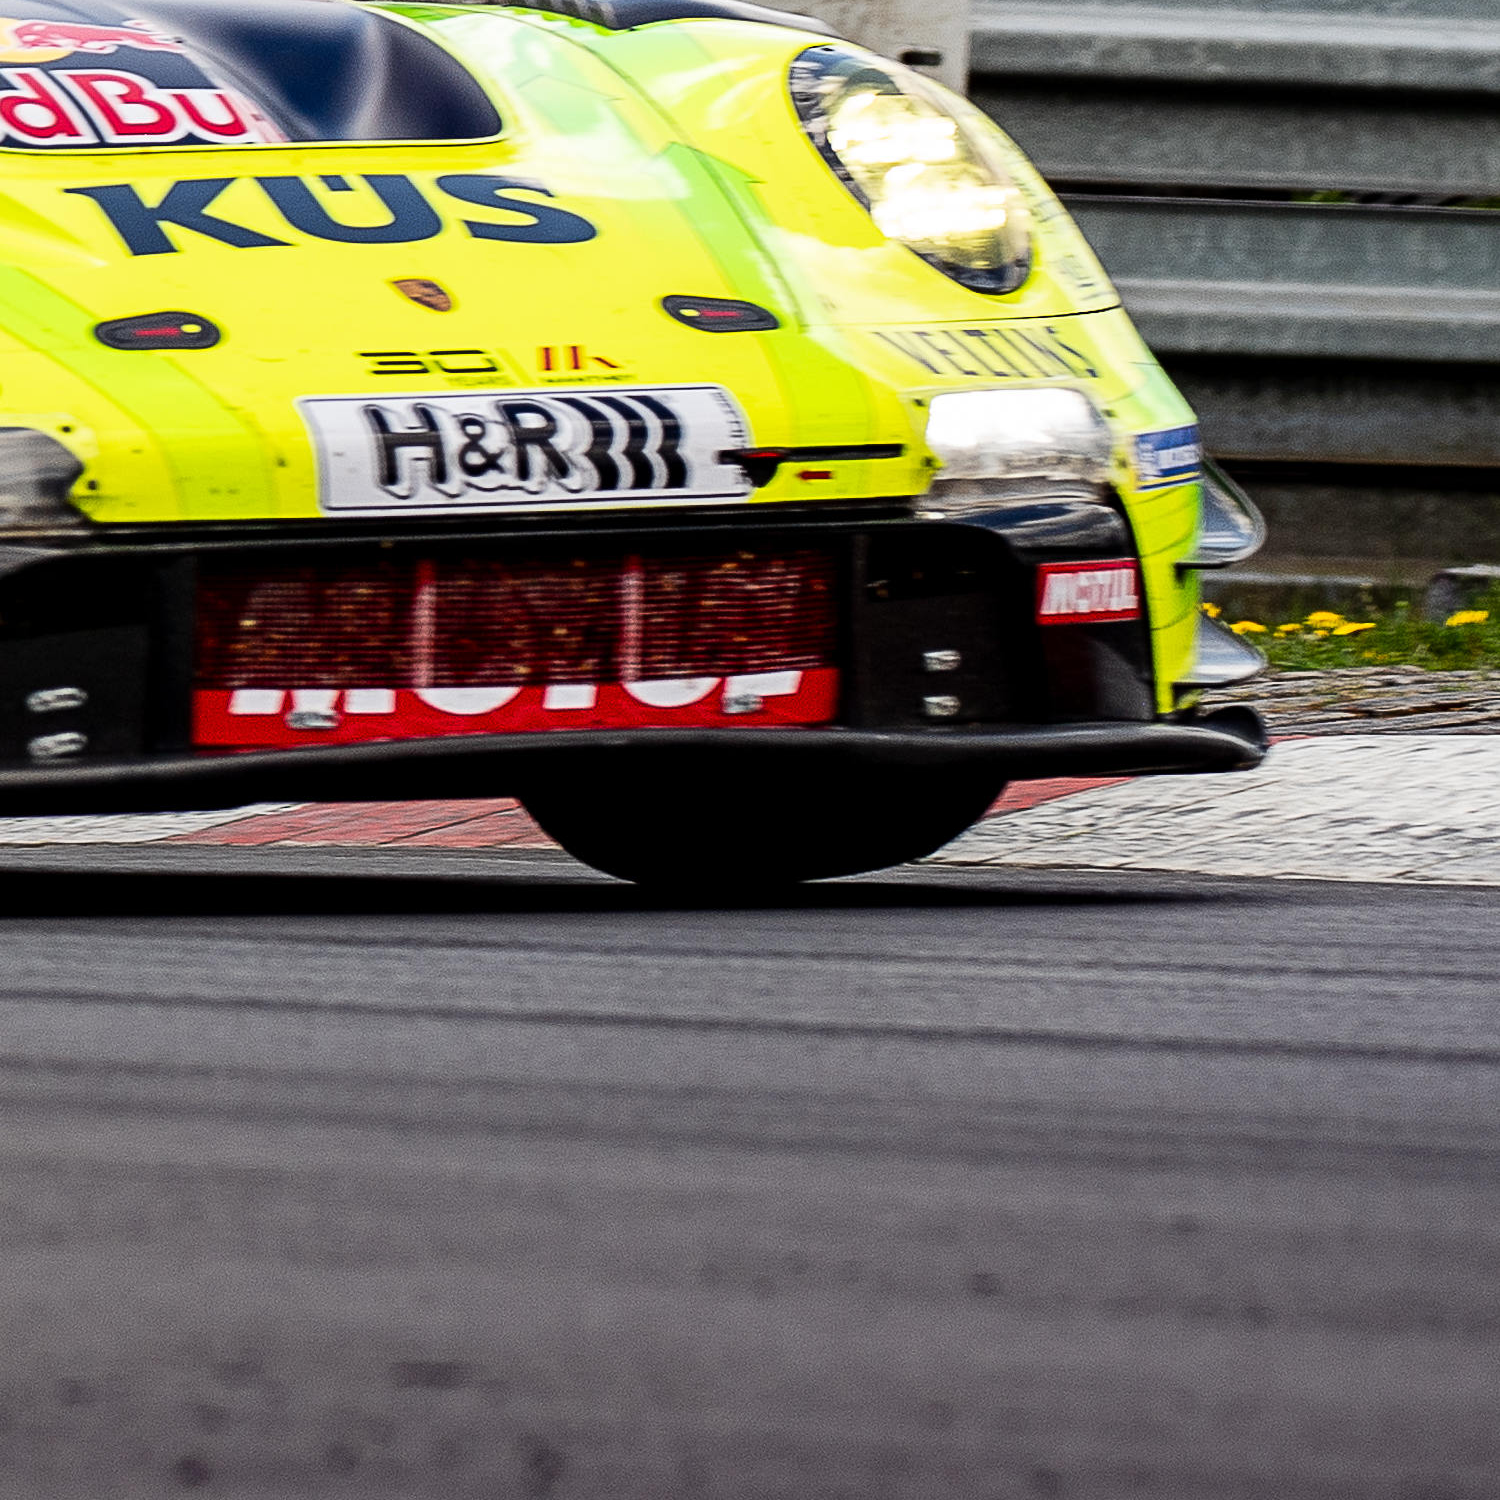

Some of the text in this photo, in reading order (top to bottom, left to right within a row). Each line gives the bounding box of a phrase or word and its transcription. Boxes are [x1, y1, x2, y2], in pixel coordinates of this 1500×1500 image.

[63, 173, 599, 257] KÜS
[361, 398, 582, 502] H&R
[1038, 567, 1140, 616] MOTUL
